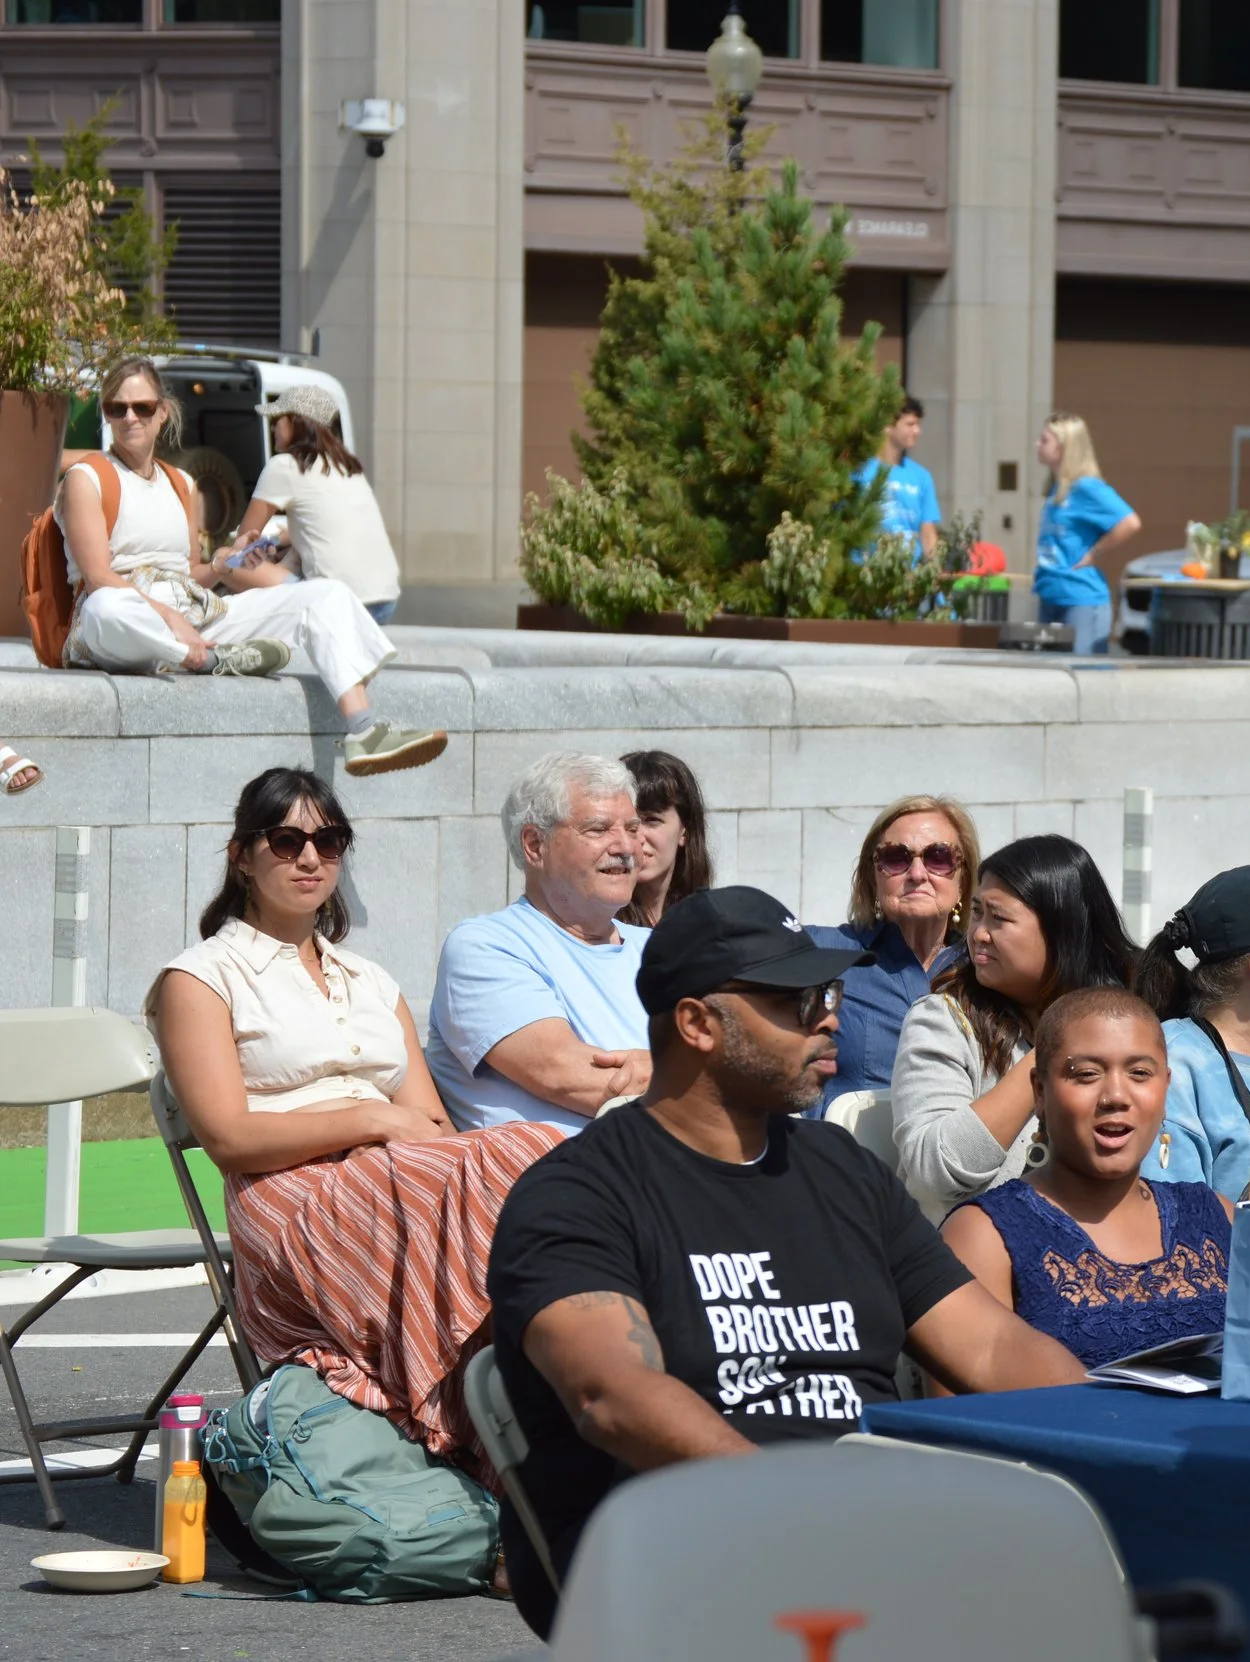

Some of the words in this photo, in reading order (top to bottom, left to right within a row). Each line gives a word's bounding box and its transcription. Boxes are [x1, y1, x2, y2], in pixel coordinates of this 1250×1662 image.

[689, 1251, 781, 1300] DOPE
[705, 1301, 860, 1354] BROTHER
[723, 1374, 862, 1419] ATHER
